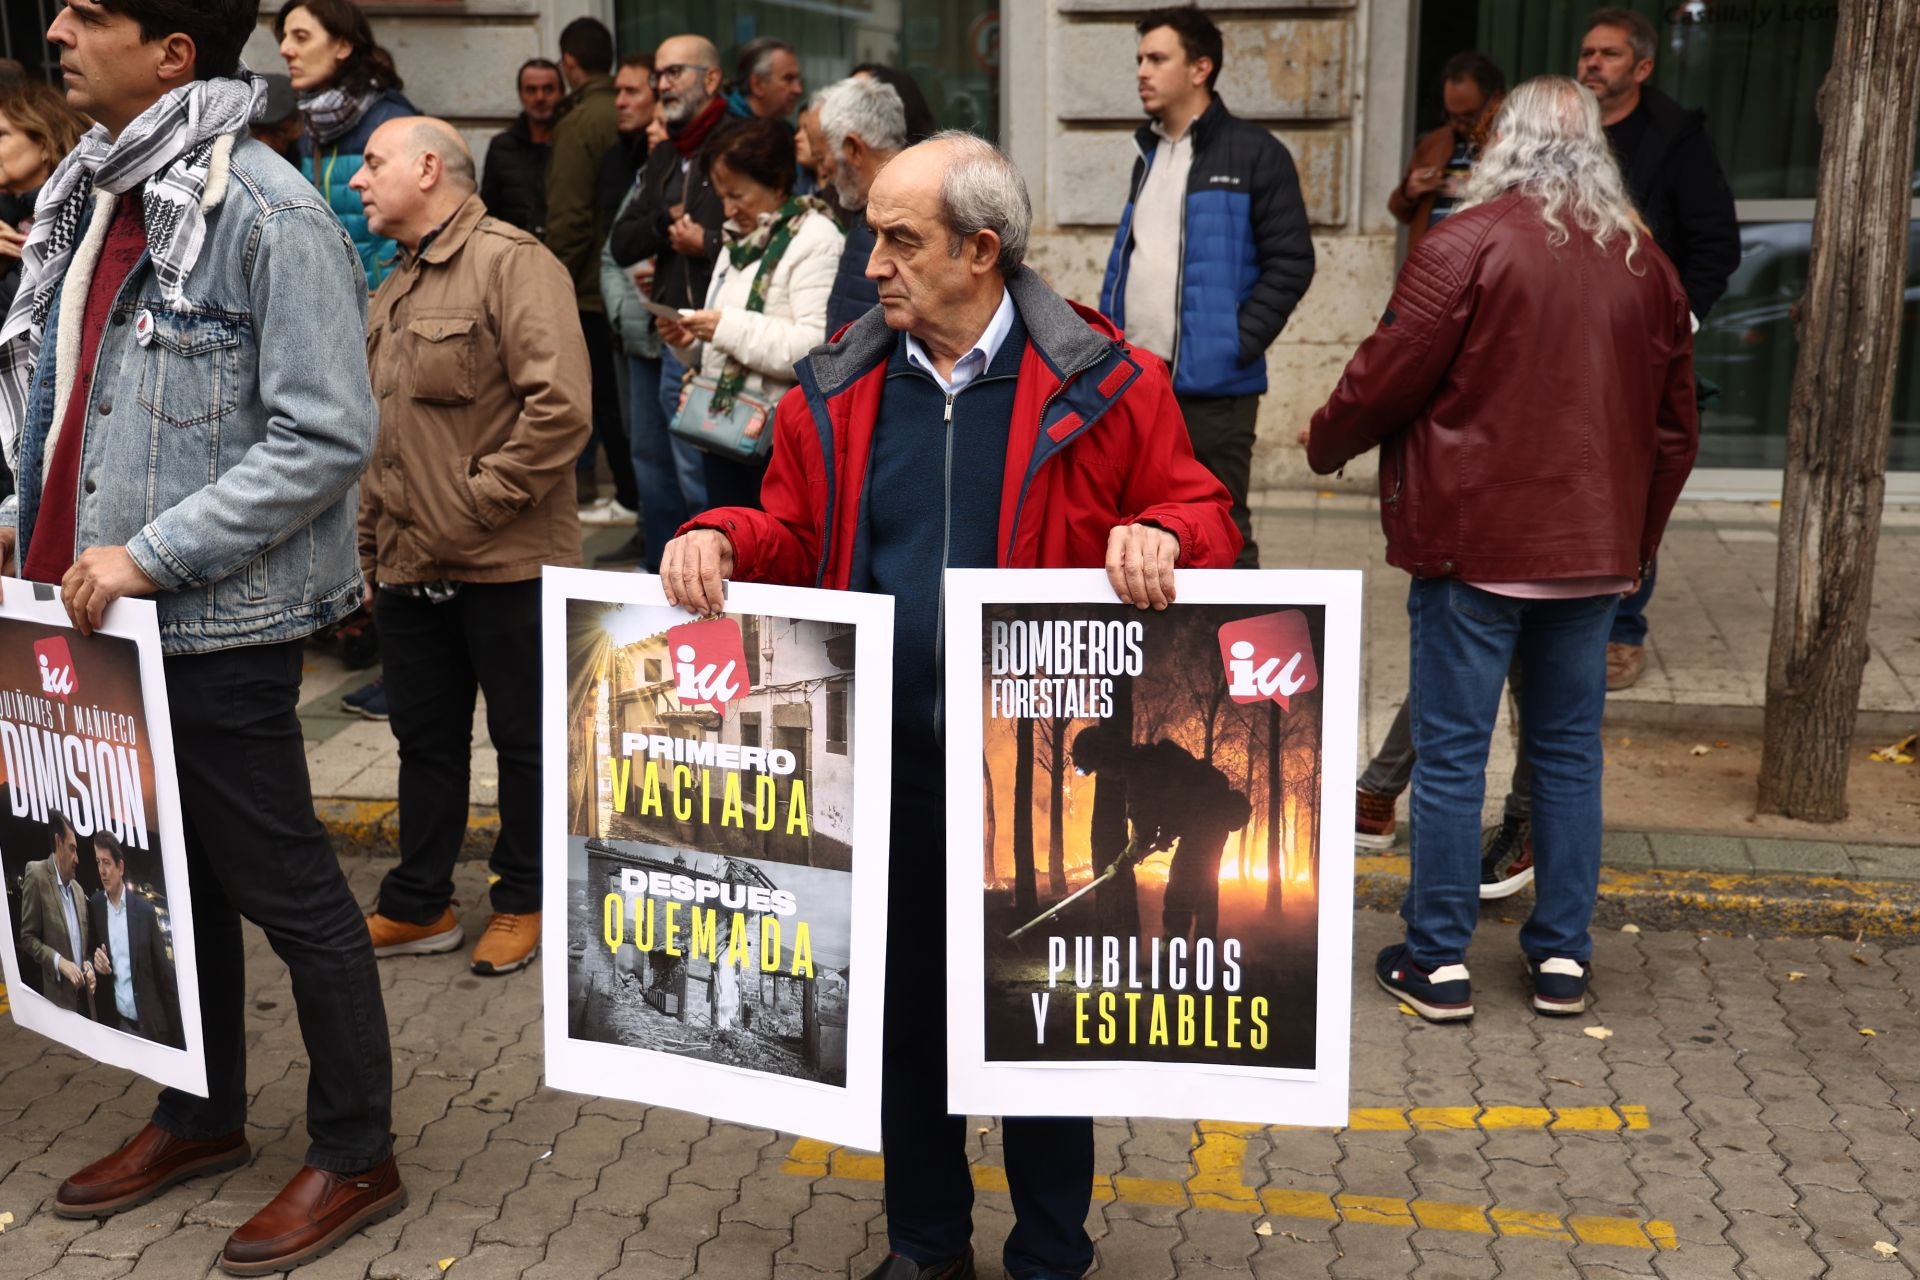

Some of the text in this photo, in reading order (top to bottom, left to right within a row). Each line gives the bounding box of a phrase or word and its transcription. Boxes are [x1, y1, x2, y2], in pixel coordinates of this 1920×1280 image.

[1757, 8, 1776, 28] y
[991, 620, 1143, 677] BOMBEROS
[58, 703, 66, 732] Y
[73, 704, 137, 746] MAÑUECO
[991, 678, 1113, 719] FORESTALES
[622, 731, 796, 775] PRIMERO
[0, 719, 150, 851] DIMISION
[609, 757, 810, 836] VACIADA
[620, 868, 797, 916] DESPUES
[604, 893, 815, 978] QUEMADA
[1048, 935, 1242, 992] PUBLICOS
[1032, 991, 1269, 1051] Y ESTABLES
